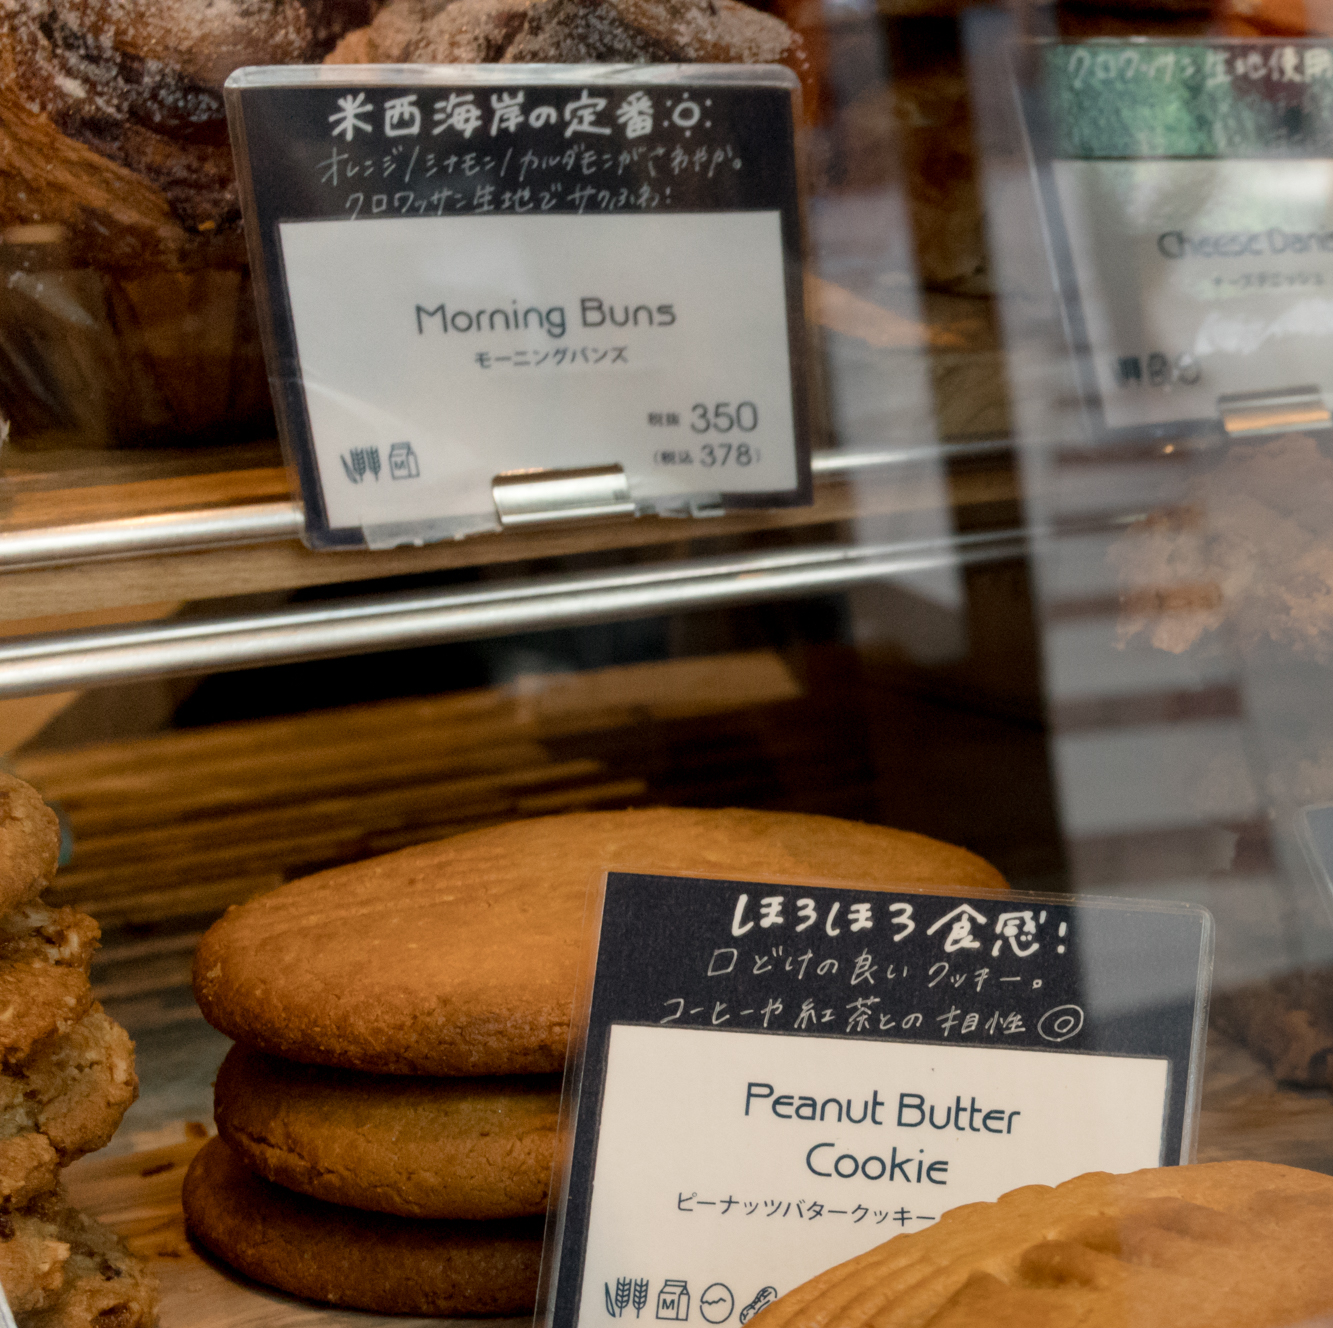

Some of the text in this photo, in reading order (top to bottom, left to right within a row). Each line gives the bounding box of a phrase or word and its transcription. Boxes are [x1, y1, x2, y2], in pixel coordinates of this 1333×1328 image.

[328, 89, 654, 144] 米西海岸の定番
[416, 298, 677, 337] Morning Buns
[474, 346, 629, 370] モーニングバンズ
[690, 401, 759, 434] 350
[745, 1082, 1021, 1135] Peanut Butter
[805, 1142, 949, 1184] Cookie
[677, 1192, 937, 1229] ピーナッツバタークッキー
